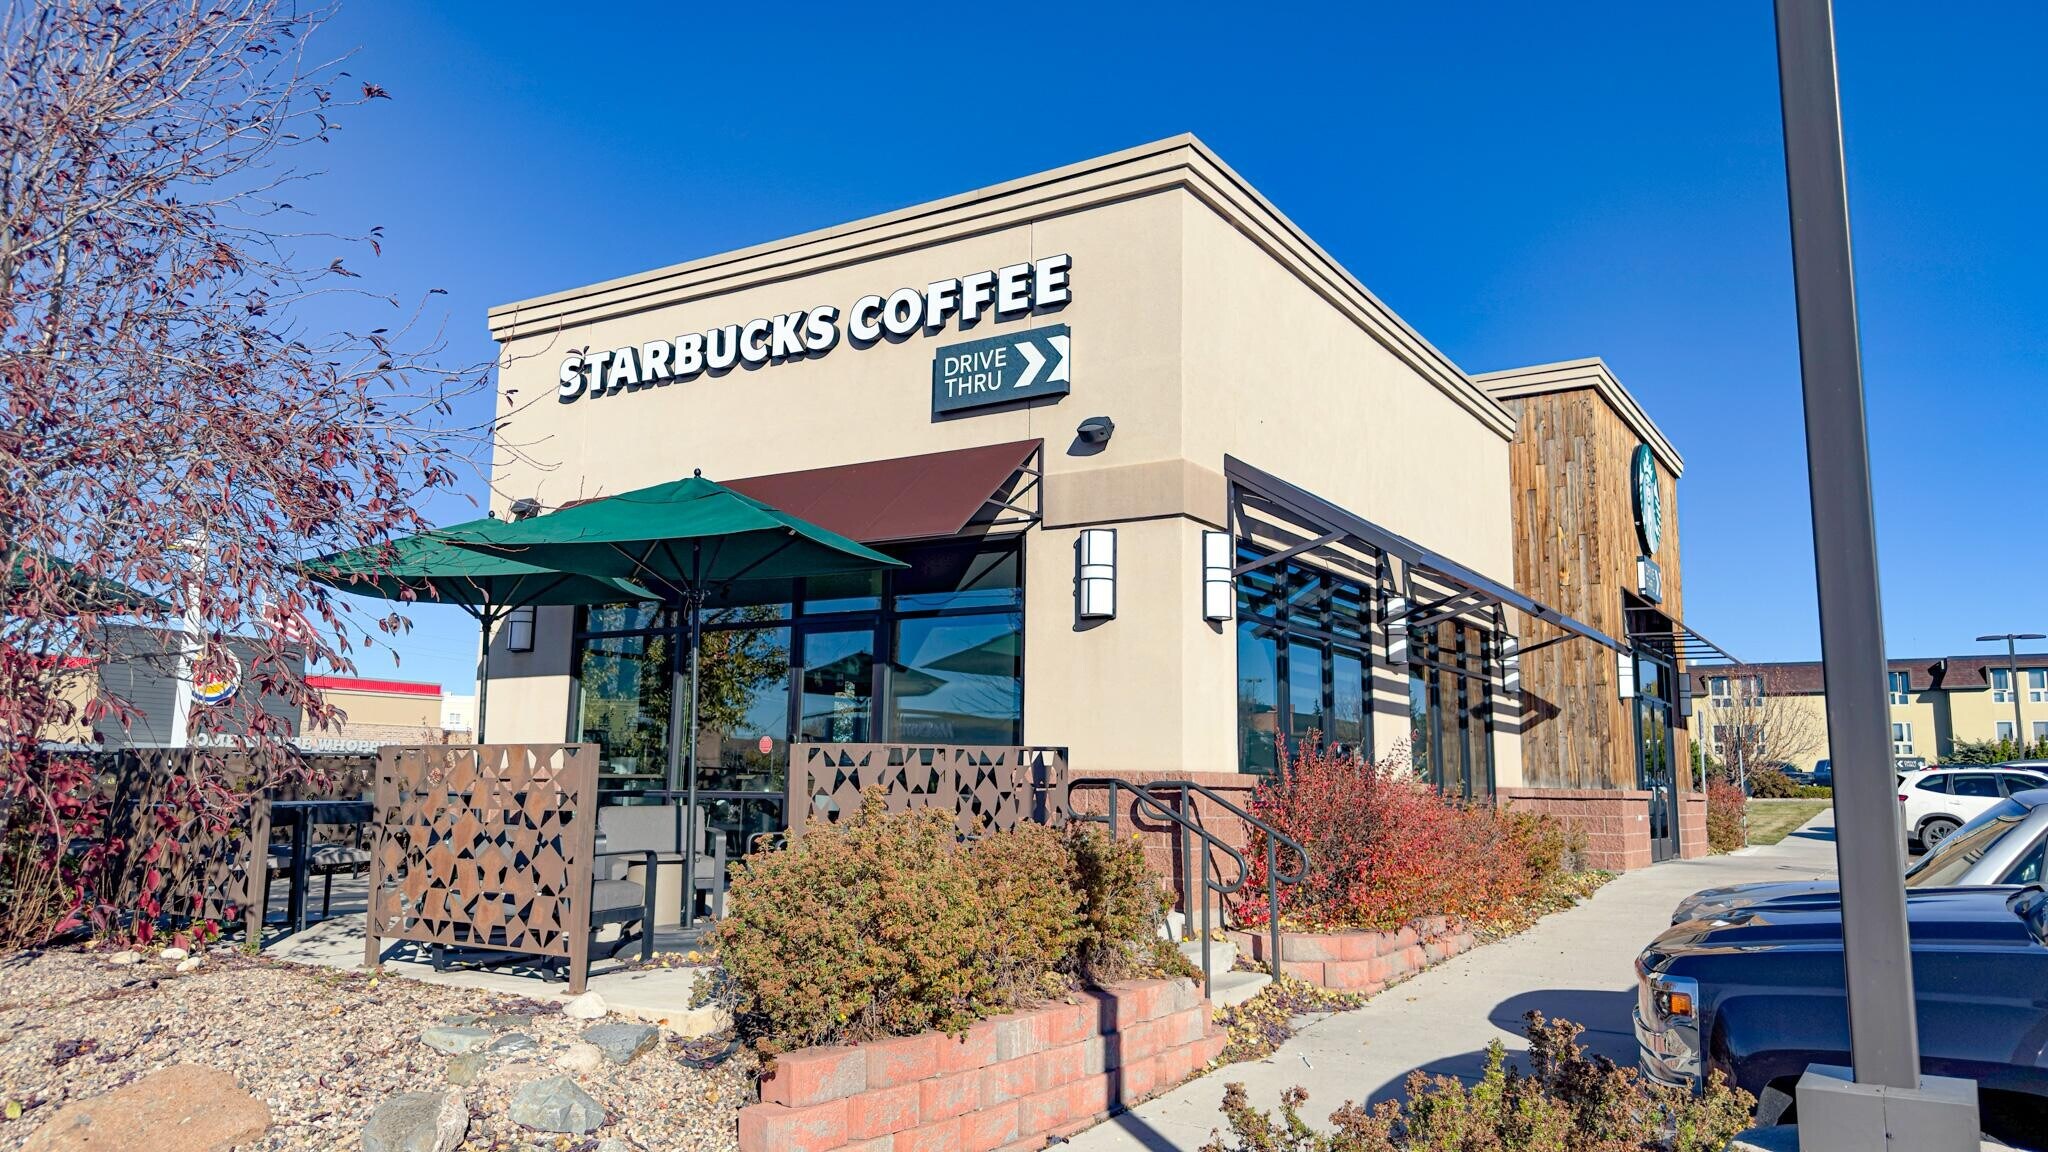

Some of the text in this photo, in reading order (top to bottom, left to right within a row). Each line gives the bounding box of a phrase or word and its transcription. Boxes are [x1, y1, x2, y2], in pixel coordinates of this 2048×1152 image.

[558, 253, 1071, 398] STARBUCKS COFFEE
[944, 347, 1007, 377] DRIVE
[944, 370, 1002, 398] THRU
[190, 733, 237, 748] OME
